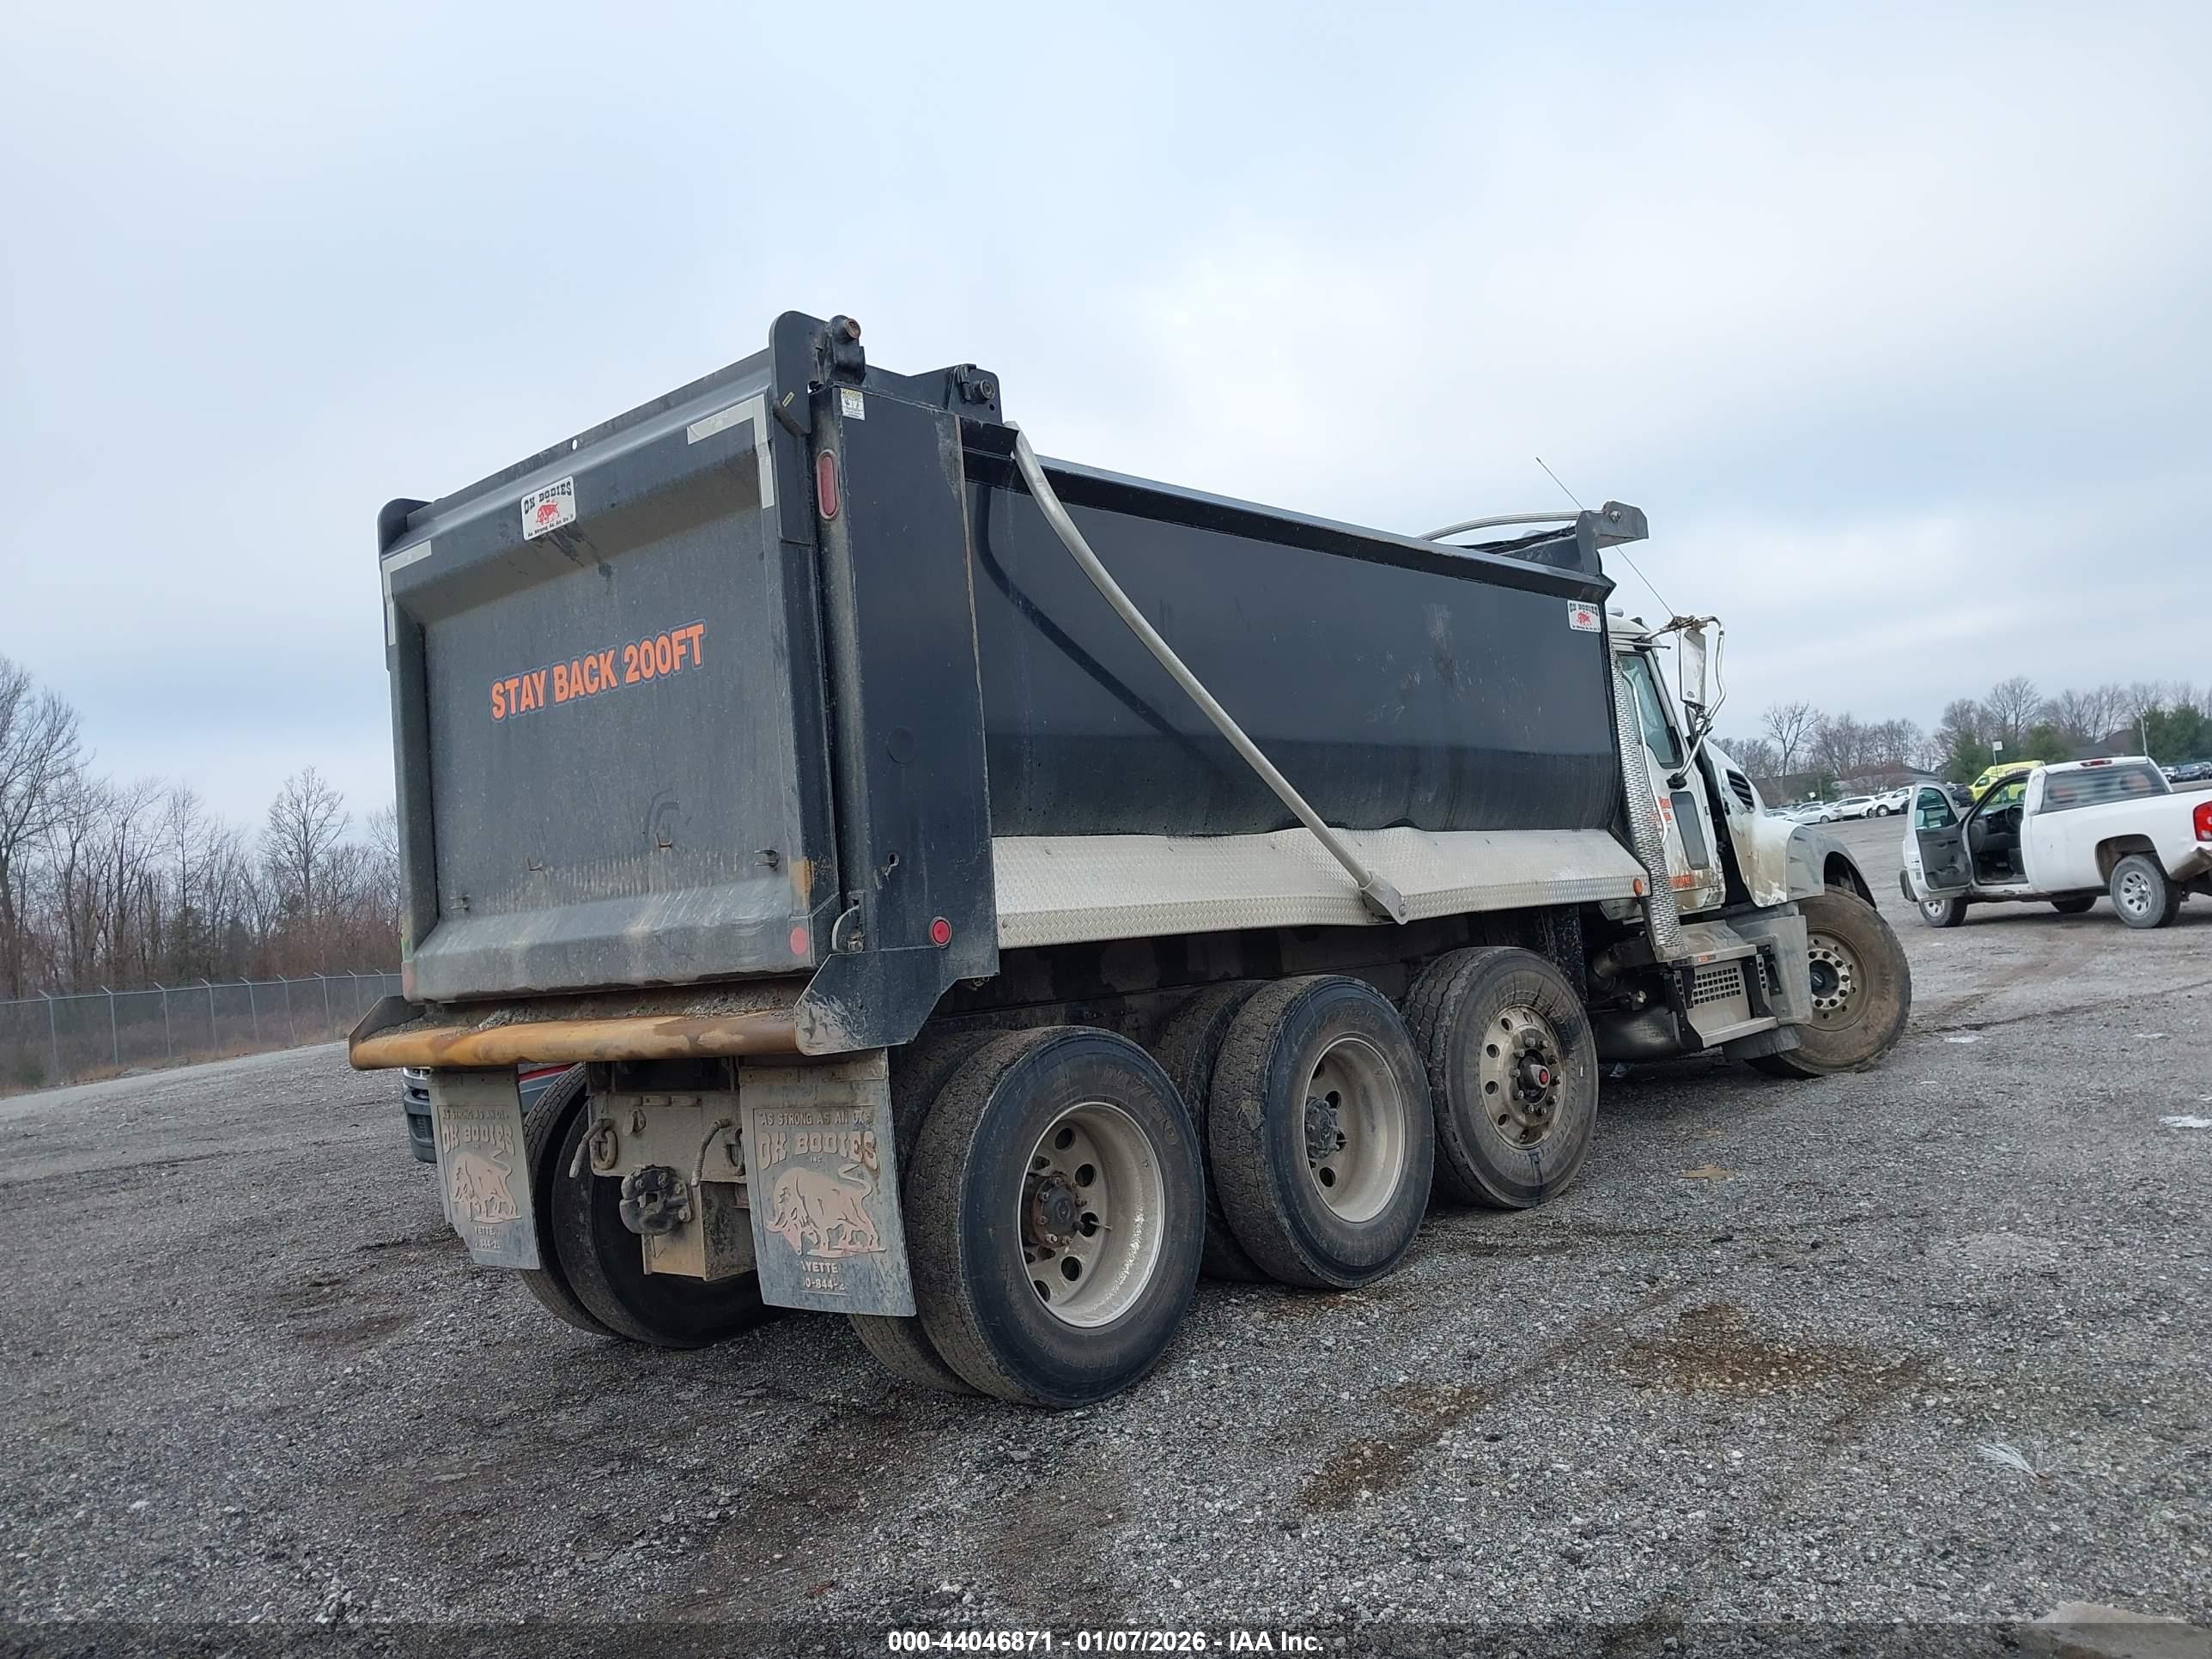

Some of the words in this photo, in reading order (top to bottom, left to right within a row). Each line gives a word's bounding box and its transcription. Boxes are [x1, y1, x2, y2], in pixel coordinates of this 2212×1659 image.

[538, 481, 572, 502] BODIES
[490, 670, 547, 720] STAY
[552, 649, 617, 703] BACK
[623, 623, 705, 684] 200FT
[777, 1112, 813, 1126] STRONG
[817, 1112, 830, 1126] AS
[835, 1111, 848, 1125] AN
[757, 1132, 787, 1170] OX
[794, 1129, 879, 1171] BODIES
